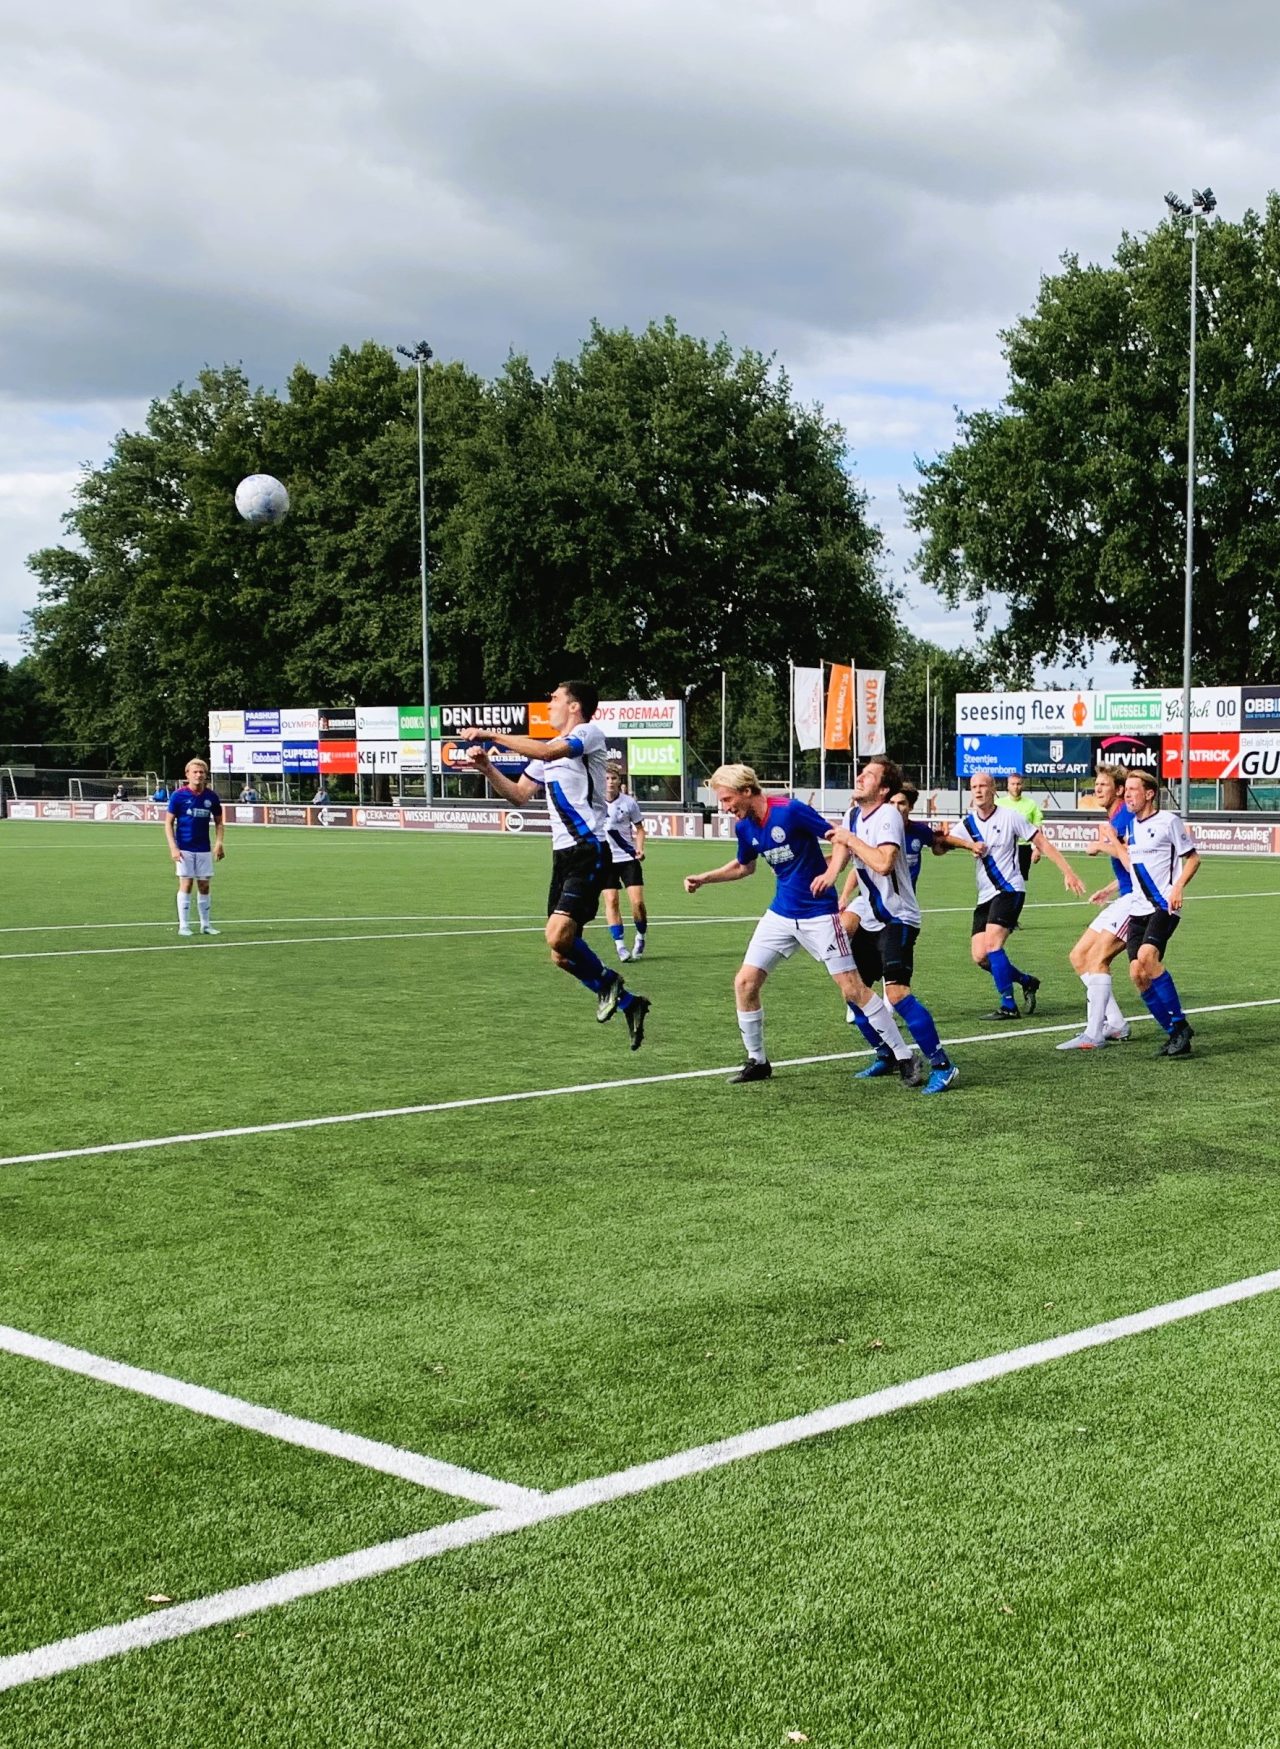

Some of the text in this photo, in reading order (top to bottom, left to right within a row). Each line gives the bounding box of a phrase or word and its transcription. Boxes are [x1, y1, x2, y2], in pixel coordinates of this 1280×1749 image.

[866, 679, 878, 725] KNVB
[442, 706, 525, 726] DEN LEEUW
[592, 707, 675, 720] OYS ROEMAAT
[961, 700, 1065, 725] seesing flex
[1111, 704, 1161, 718] WESSELS BV
[283, 749, 318, 759] CUPPERS
[380, 751, 397, 764] FIT
[963, 753, 998, 765] Steentjes
[1096, 748, 1157, 766] Lurvink
[1025, 763, 1088, 773] STATE OF ART
[404, 811, 501, 824] WISSELINKCARAVANS.NL
[1057, 825, 1099, 840] Tenten
